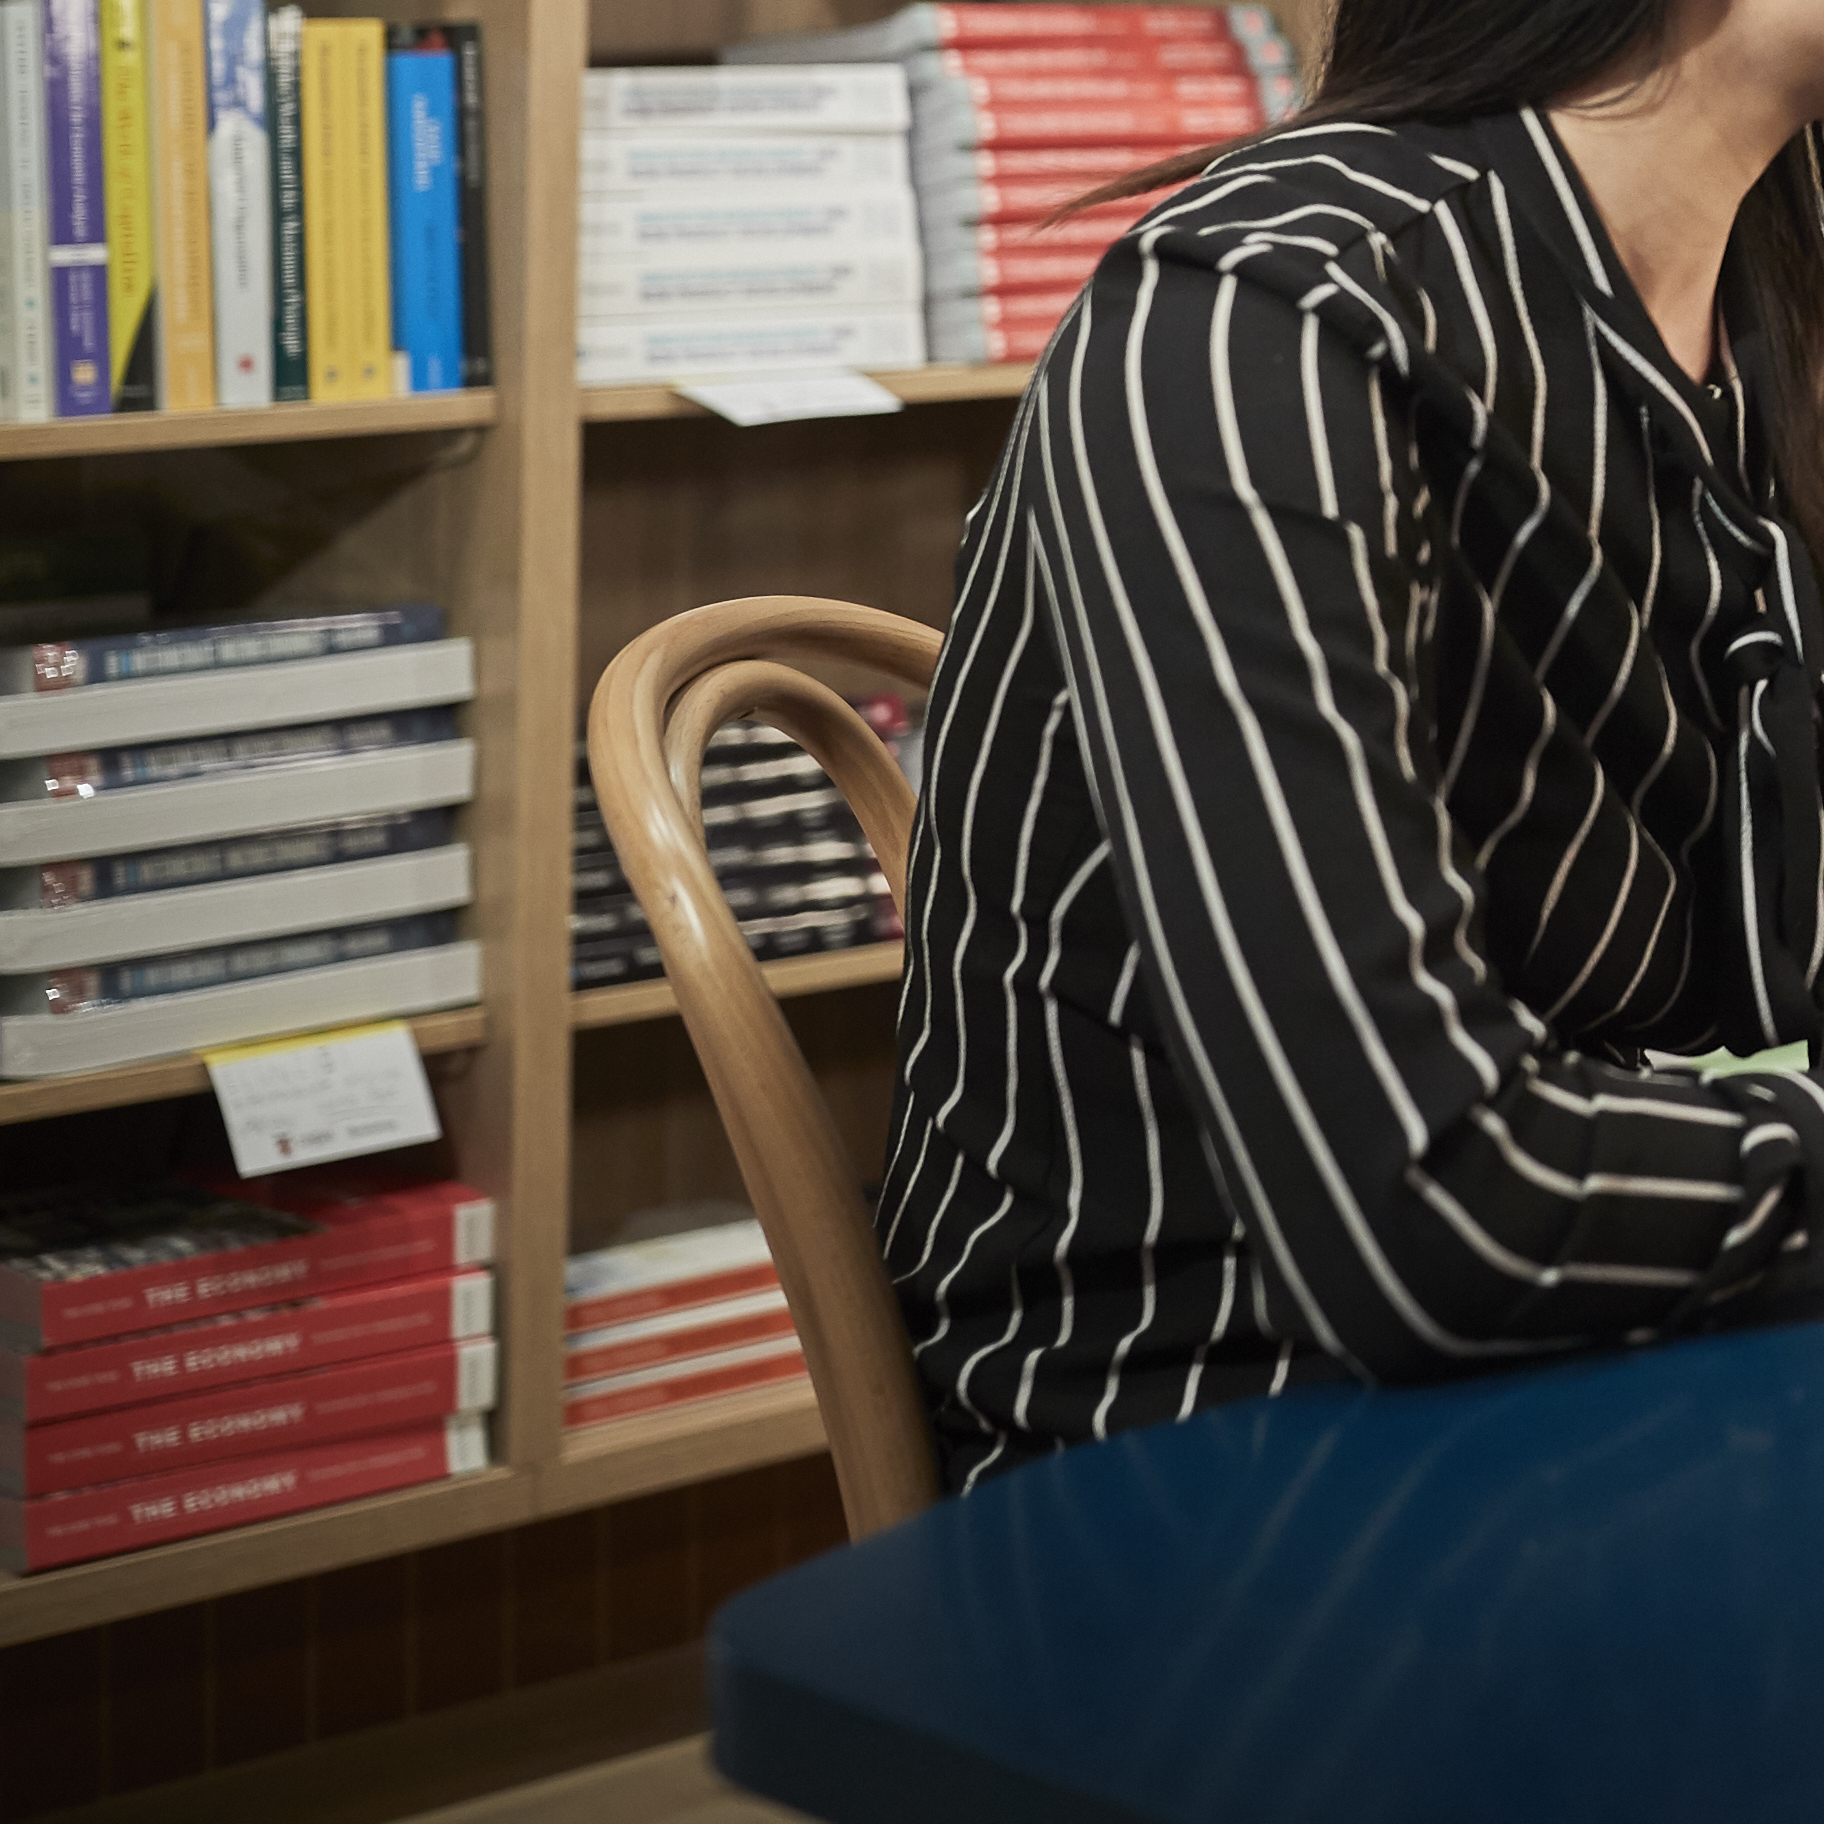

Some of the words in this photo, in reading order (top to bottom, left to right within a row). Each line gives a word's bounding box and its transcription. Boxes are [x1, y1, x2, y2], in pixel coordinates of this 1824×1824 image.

[144, 1276, 191, 1312] THE
[198, 1259, 308, 1302] ECONOMY
[132, 1349, 181, 1382] THE
[188, 1333, 302, 1375] ECONOMY
[135, 1421, 183, 1454] THE
[190, 1401, 304, 1445] ECONOMY
[131, 1492, 177, 1525] THE
[184, 1471, 298, 1513] ECONOMY
